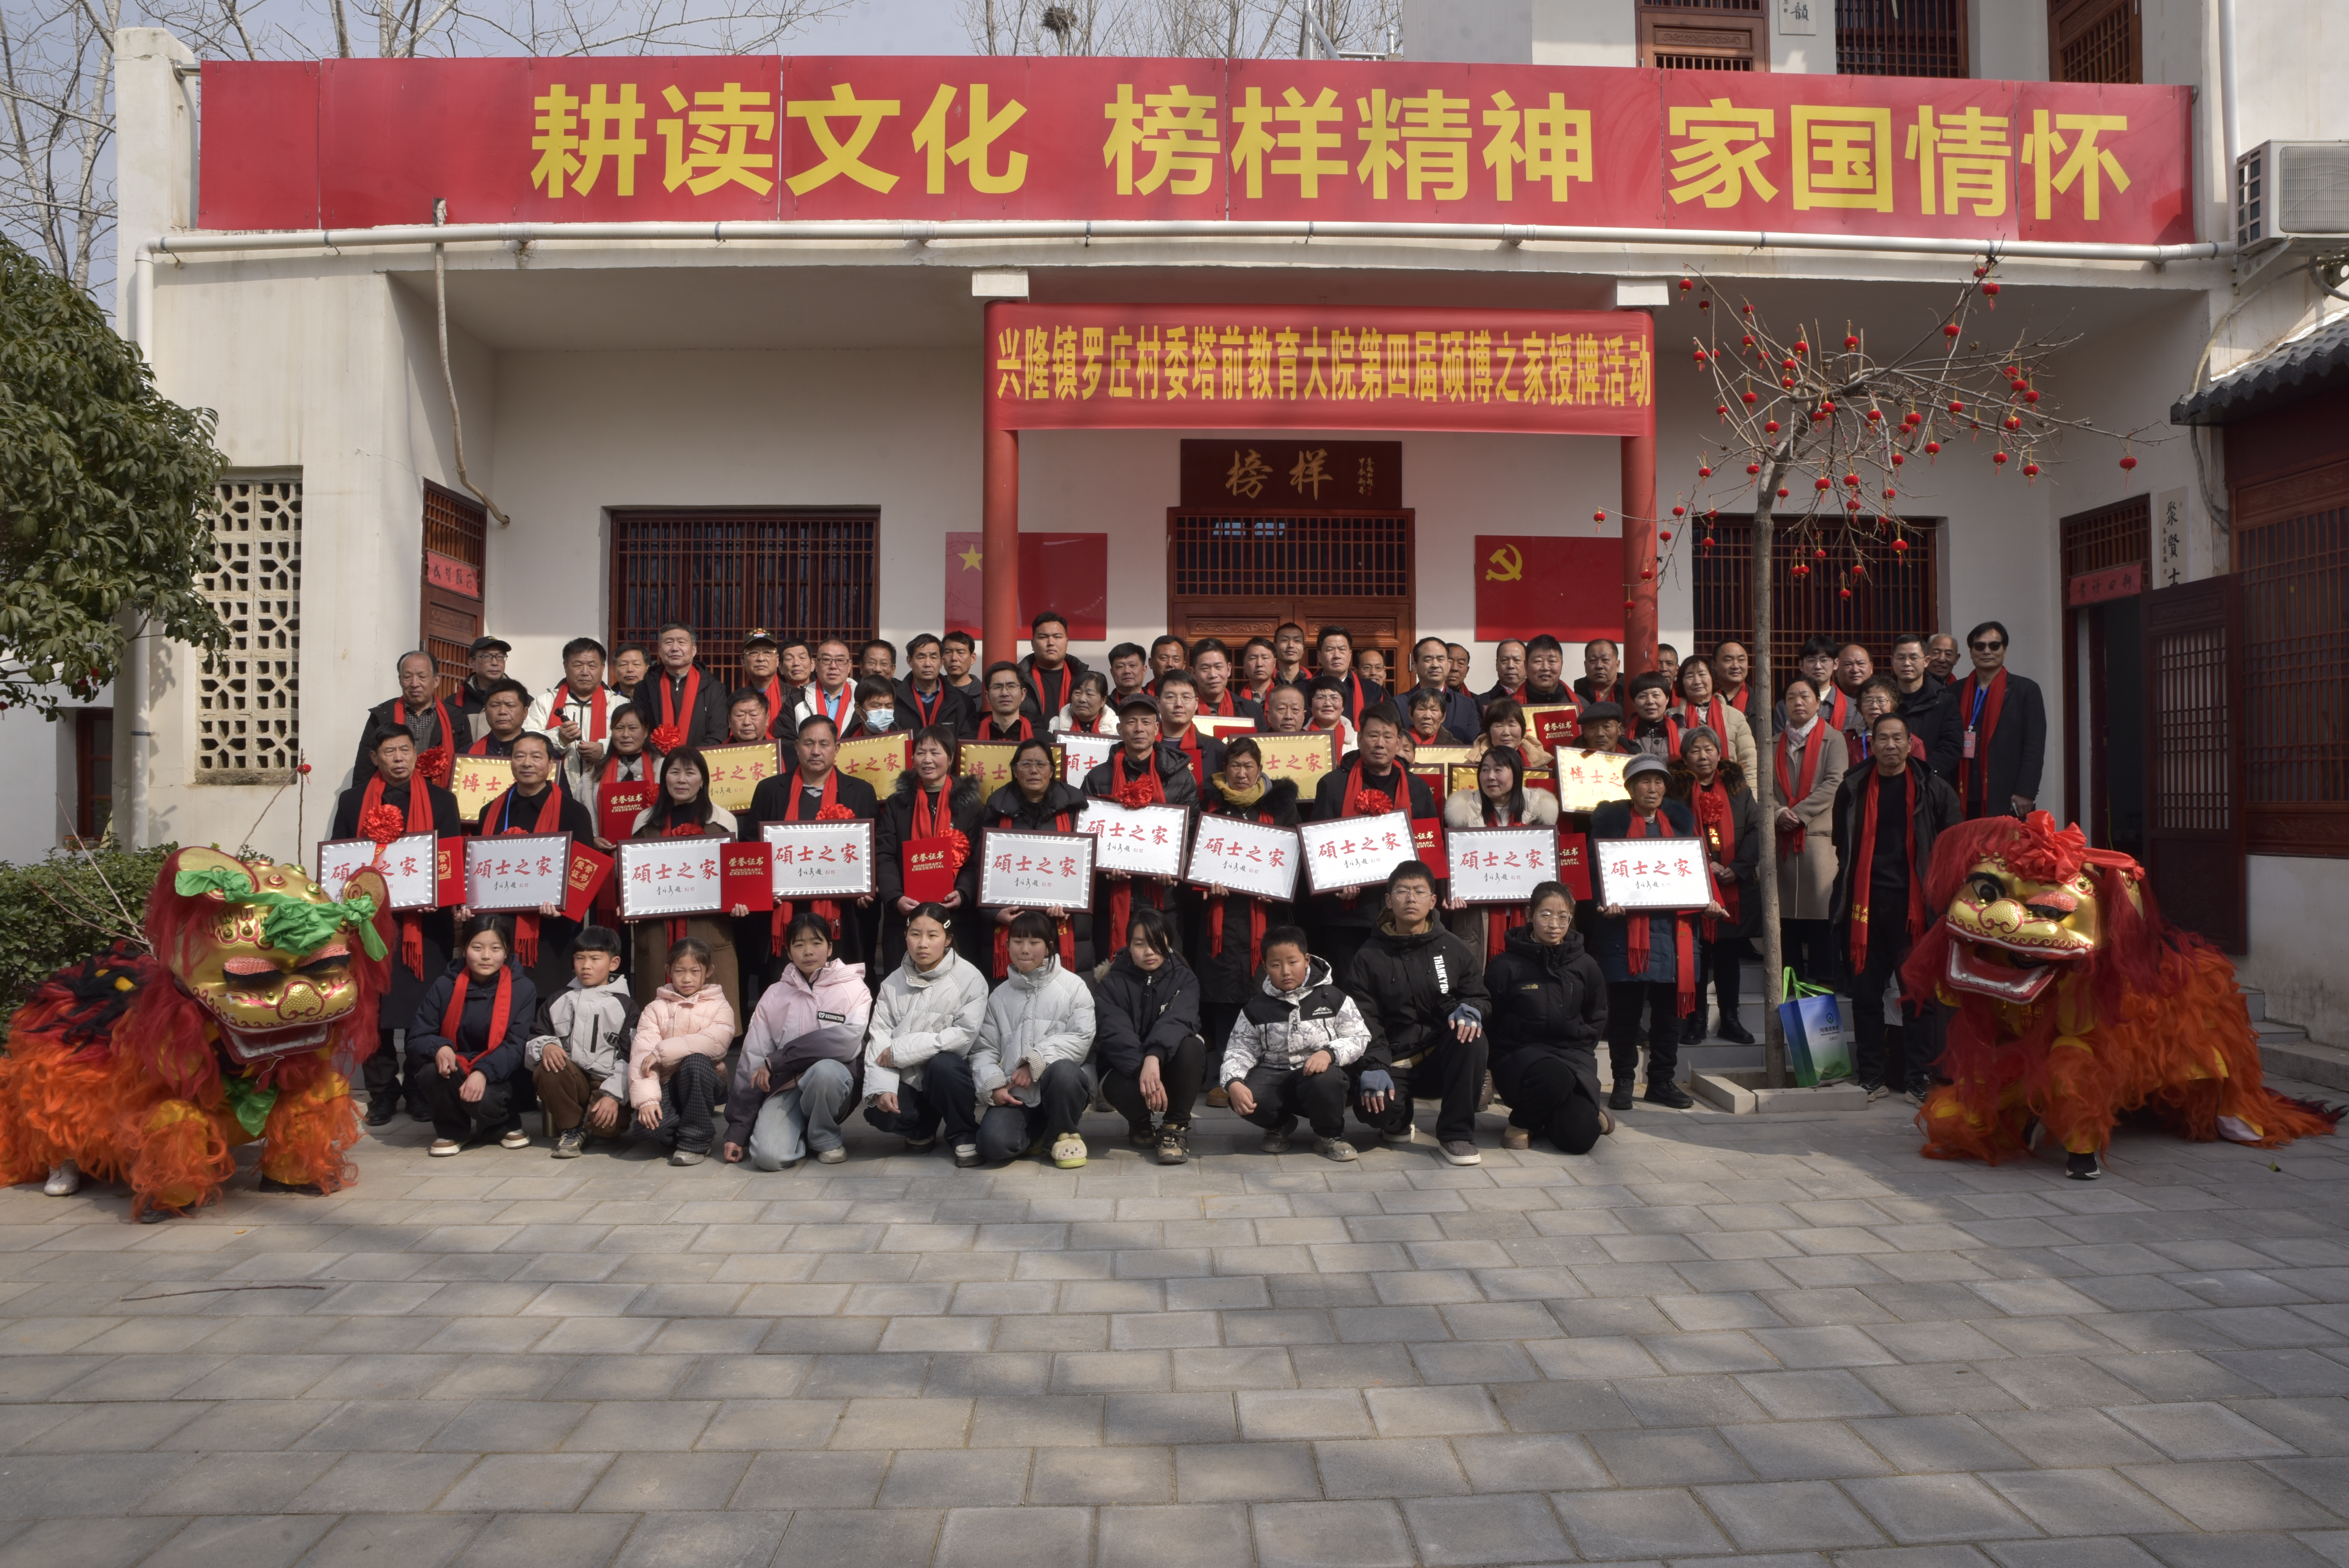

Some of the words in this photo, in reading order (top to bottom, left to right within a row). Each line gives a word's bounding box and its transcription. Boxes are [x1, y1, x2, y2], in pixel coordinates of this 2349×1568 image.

[531, 82, 1028, 198] 耕读文化
[1103, 84, 1593, 202] 榜样精神
[1668, 97, 2131, 220] 家国情怀
[997, 325, 1650, 408] 兴隆镇罗庄村委塔前教育大院第四届硕博之家授牌活动
[1544, 721, 1572, 731] 荣誉证书
[710, 762, 766, 782] 士之家
[833, 753, 901, 774] 士之家
[1265, 753, 1323, 772] 士之家
[611, 794, 643, 805] 荣誉证书
[1414, 831, 1434, 840] 证书
[911, 851, 944, 863] 荣誉证书
[1559, 847, 1579, 856] 证书
[330, 857, 419, 881] 碩之家
[729, 856, 764, 867] 荣誉证书
[1433, 955, 1449, 994] THANKYOU
